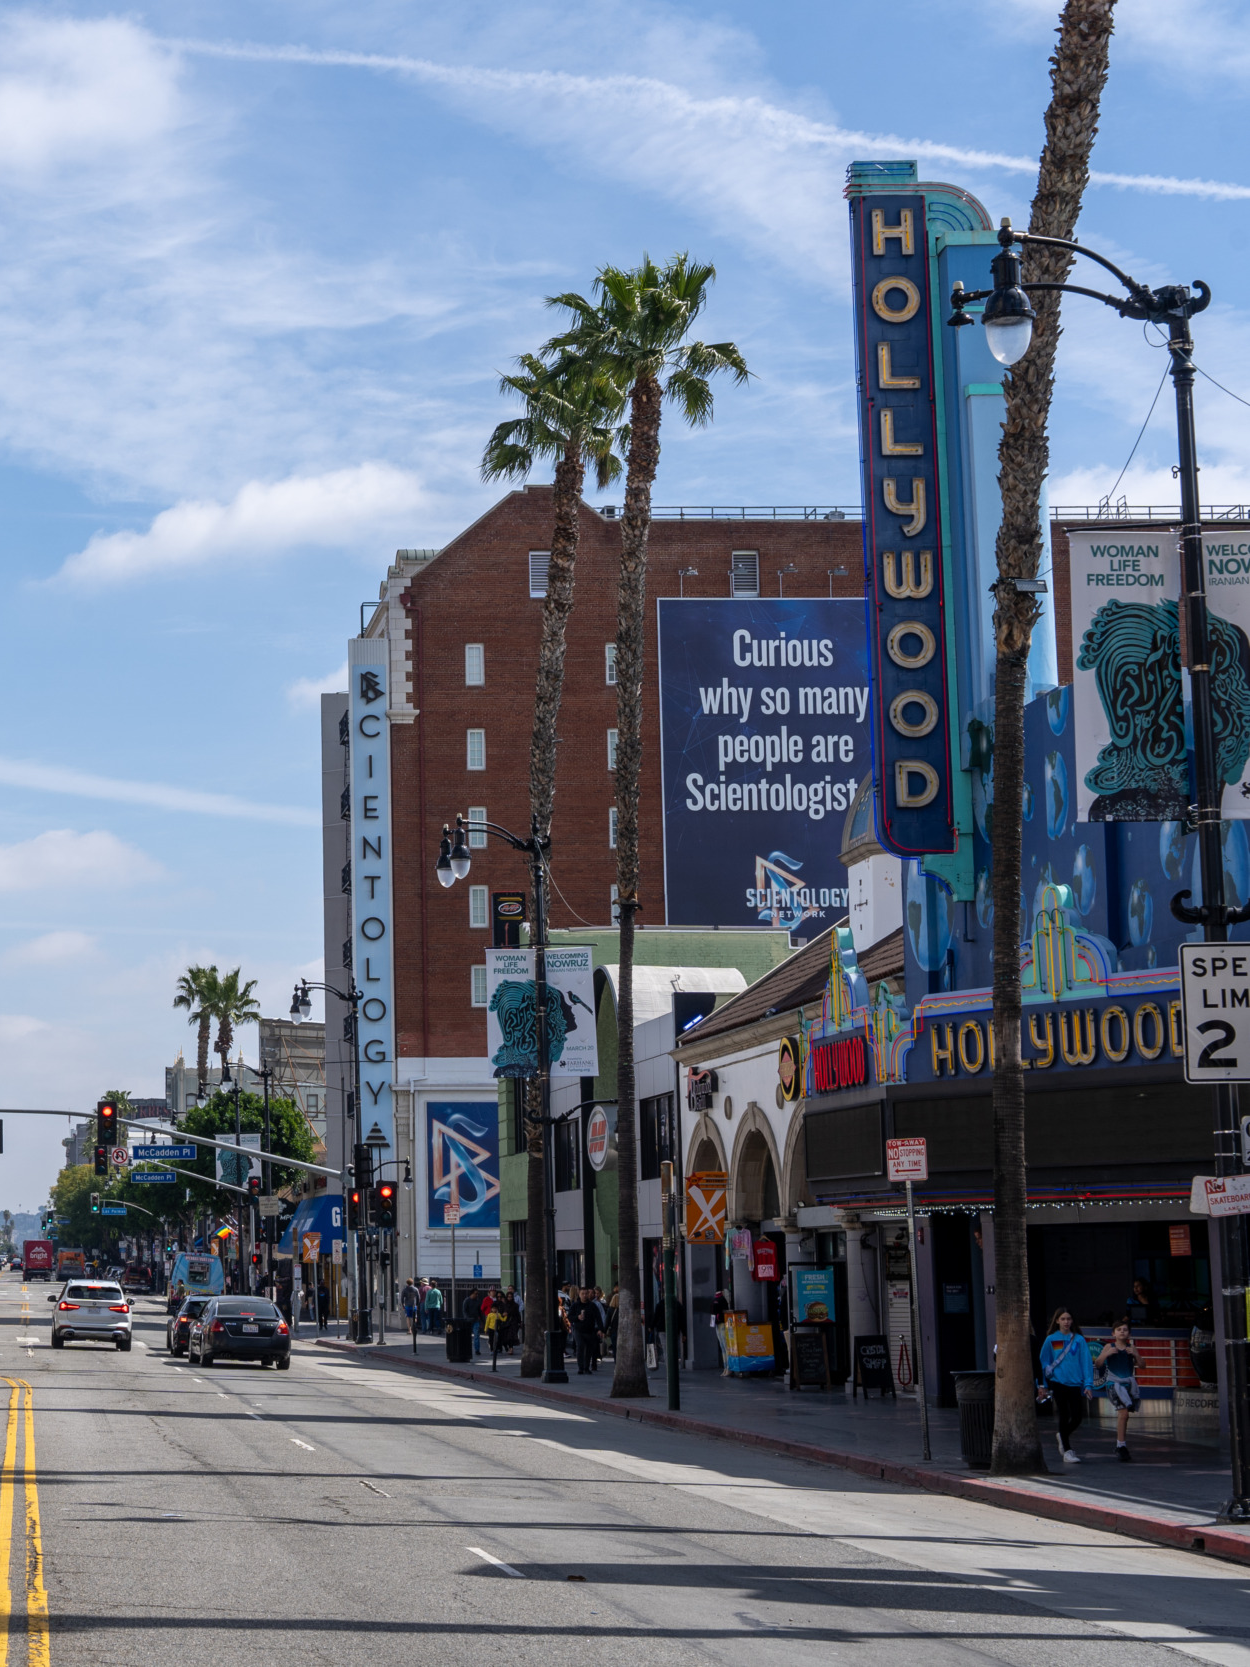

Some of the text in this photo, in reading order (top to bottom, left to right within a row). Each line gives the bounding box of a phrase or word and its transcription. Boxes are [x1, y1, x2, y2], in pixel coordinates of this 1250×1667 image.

[870, 207, 940, 808] HOLLYWOOD
[1090, 544, 1159, 558] WOMAN
[1206, 543, 1250, 556] WELC
[1109, 559, 1141, 572] LIFE
[1086, 573, 1165, 587] FREEDOM
[1208, 577, 1250, 586] IRANIAN
[732, 628, 834, 667] Curious
[699, 677, 869, 723] why so many
[718, 726, 854, 771] people are
[746, 888, 849, 908] SCIENTOLOGY
[770, 910, 826, 918] NETWORK
[545, 952, 589, 960] WELCOMING
[546, 959, 589, 968] NOWRUZ
[930, 1000, 1184, 1077] HOYWOOD
[813, 1035, 865, 1093] HOLLYWOOD
[887, 1139, 924, 1147] TOW-AWAY
[138, 1149, 181, 1157] McCadden
[888, 1148, 925, 1159] NO STOPPING
[893, 1159, 922, 1168] ANY TIME
[1210, 1193, 1250, 1205] SKATEBOAR
[29, 1252, 48, 1260] bright
